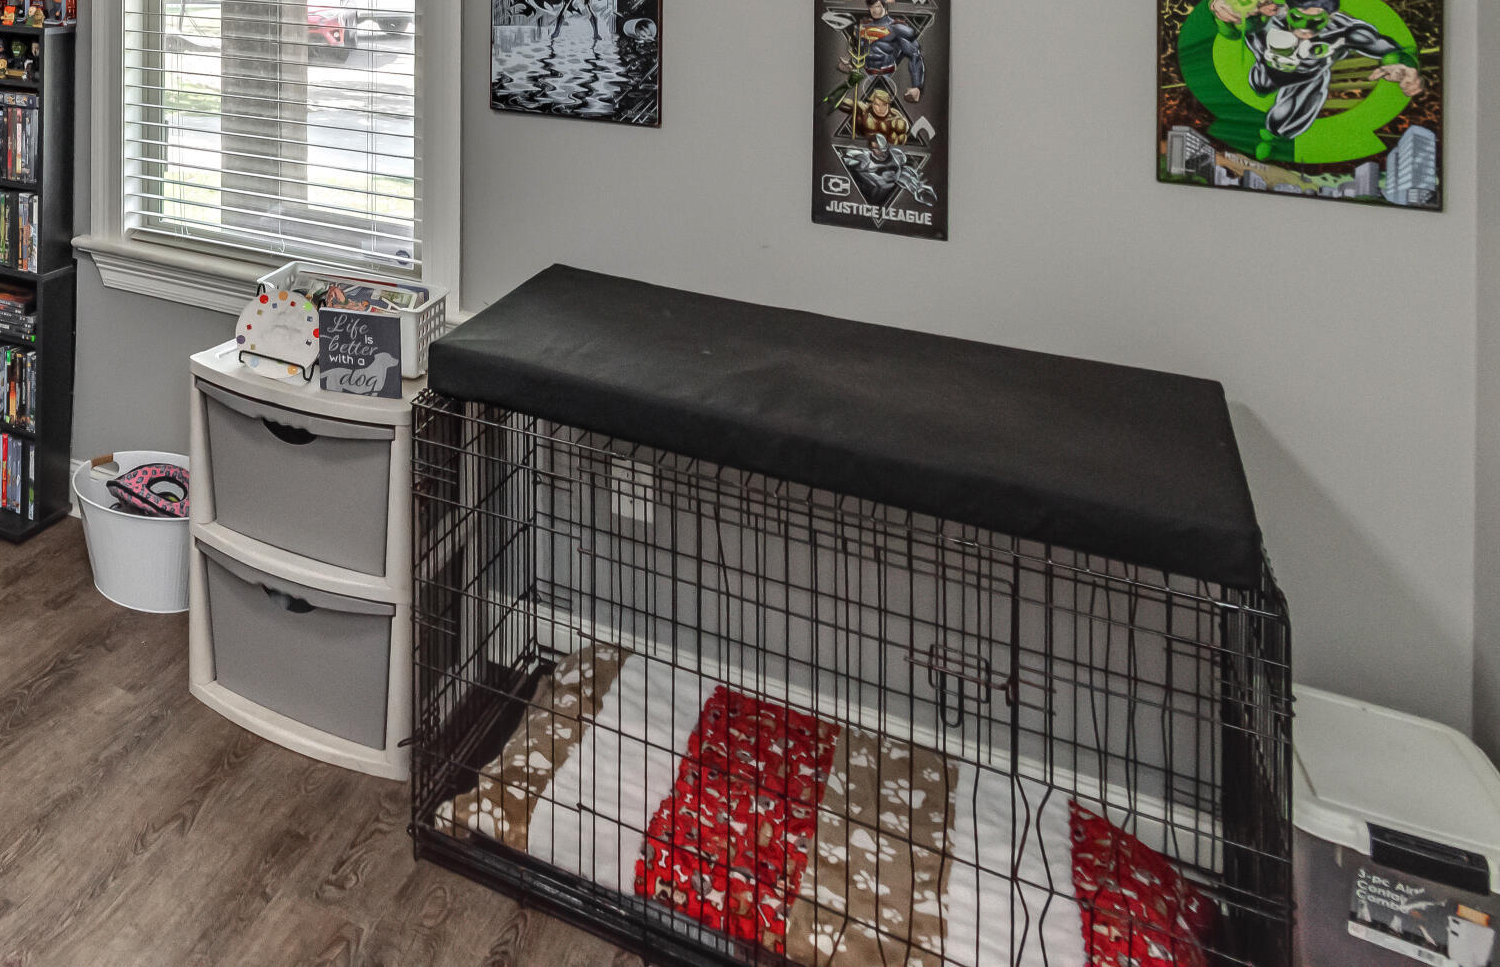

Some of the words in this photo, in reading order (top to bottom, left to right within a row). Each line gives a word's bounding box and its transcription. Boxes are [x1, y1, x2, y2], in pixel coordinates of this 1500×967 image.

[825, 199, 880, 219] JUSTICE
[881, 206, 933, 226] LEAGUE
[326, 313, 369, 340] Life
[320, 334, 378, 356] better
[328, 353, 354, 365] with
[357, 357, 365, 366] a
[340, 368, 379, 394] dog
